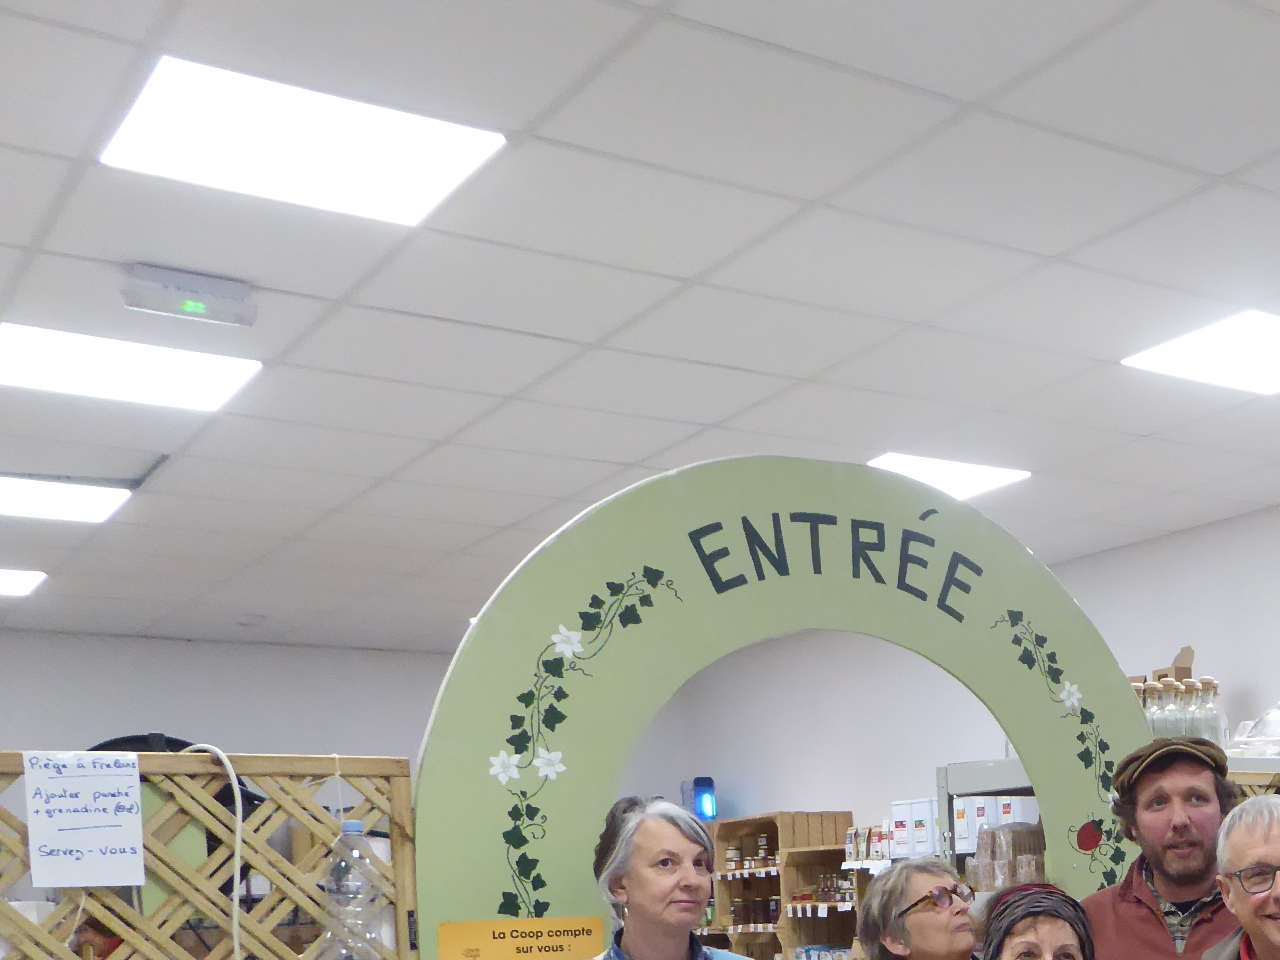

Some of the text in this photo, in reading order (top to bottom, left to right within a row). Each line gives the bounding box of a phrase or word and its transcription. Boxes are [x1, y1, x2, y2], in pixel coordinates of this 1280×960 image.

[687, 508, 983, 623] ENTRÉE
[28, 756, 67, 775] Piège
[77, 758, 86, 769] à
[32, 787, 81, 804] Ajouter
[45, 804, 110, 818] grenadine
[492, 927, 593, 943] La Coop compte
[515, 946, 533, 954] sur
[537, 944, 564, 953] vous
